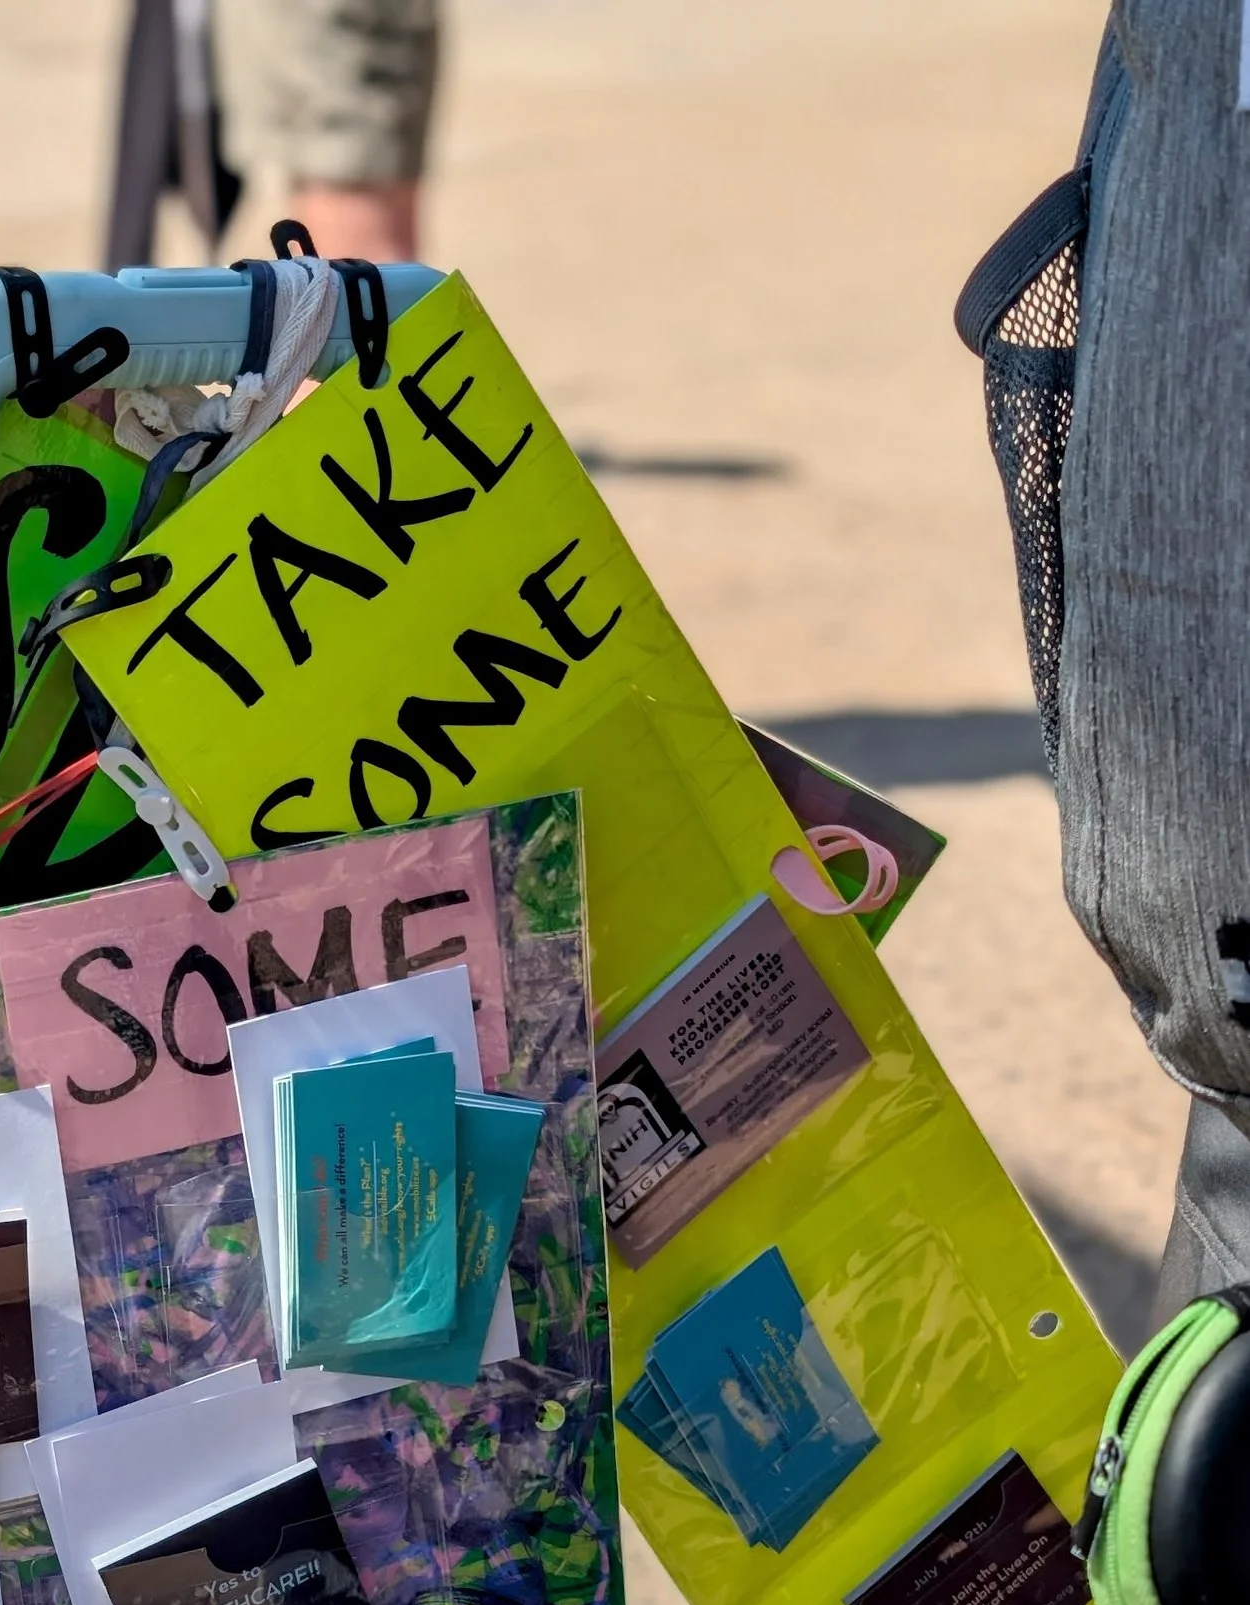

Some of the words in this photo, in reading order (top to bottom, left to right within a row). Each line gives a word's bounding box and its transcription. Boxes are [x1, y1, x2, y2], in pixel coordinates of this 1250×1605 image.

[127, 330, 533, 707] TAKE
[61, 889, 482, 1105] SOME
[669, 1018, 695, 1044] FOR
[697, 990, 725, 1016] THE
[677, 999, 749, 1066] PROGRAMS
[752, 964, 784, 998] LOST
[334, 1123, 347, 1185] difference!
[609, 1118, 649, 1161] NIH
[614, 1140, 692, 1212] VIGILS
[334, 1198, 347, 1227] make
[335, 1227, 348, 1245] all
[340, 1246, 349, 1265] can
[338, 1268, 349, 1288] We
[913, 1565, 939, 1591] July
[997, 1555, 1029, 1582] Lives
[1028, 1535, 1049, 1554] On
[1006, 1555, 1046, 1594] action!
[203, 1577, 239, 1598] Yes
[242, 1565, 263, 1585] to
[951, 1581, 978, 1605] Join
[975, 1562, 998, 1583] the
